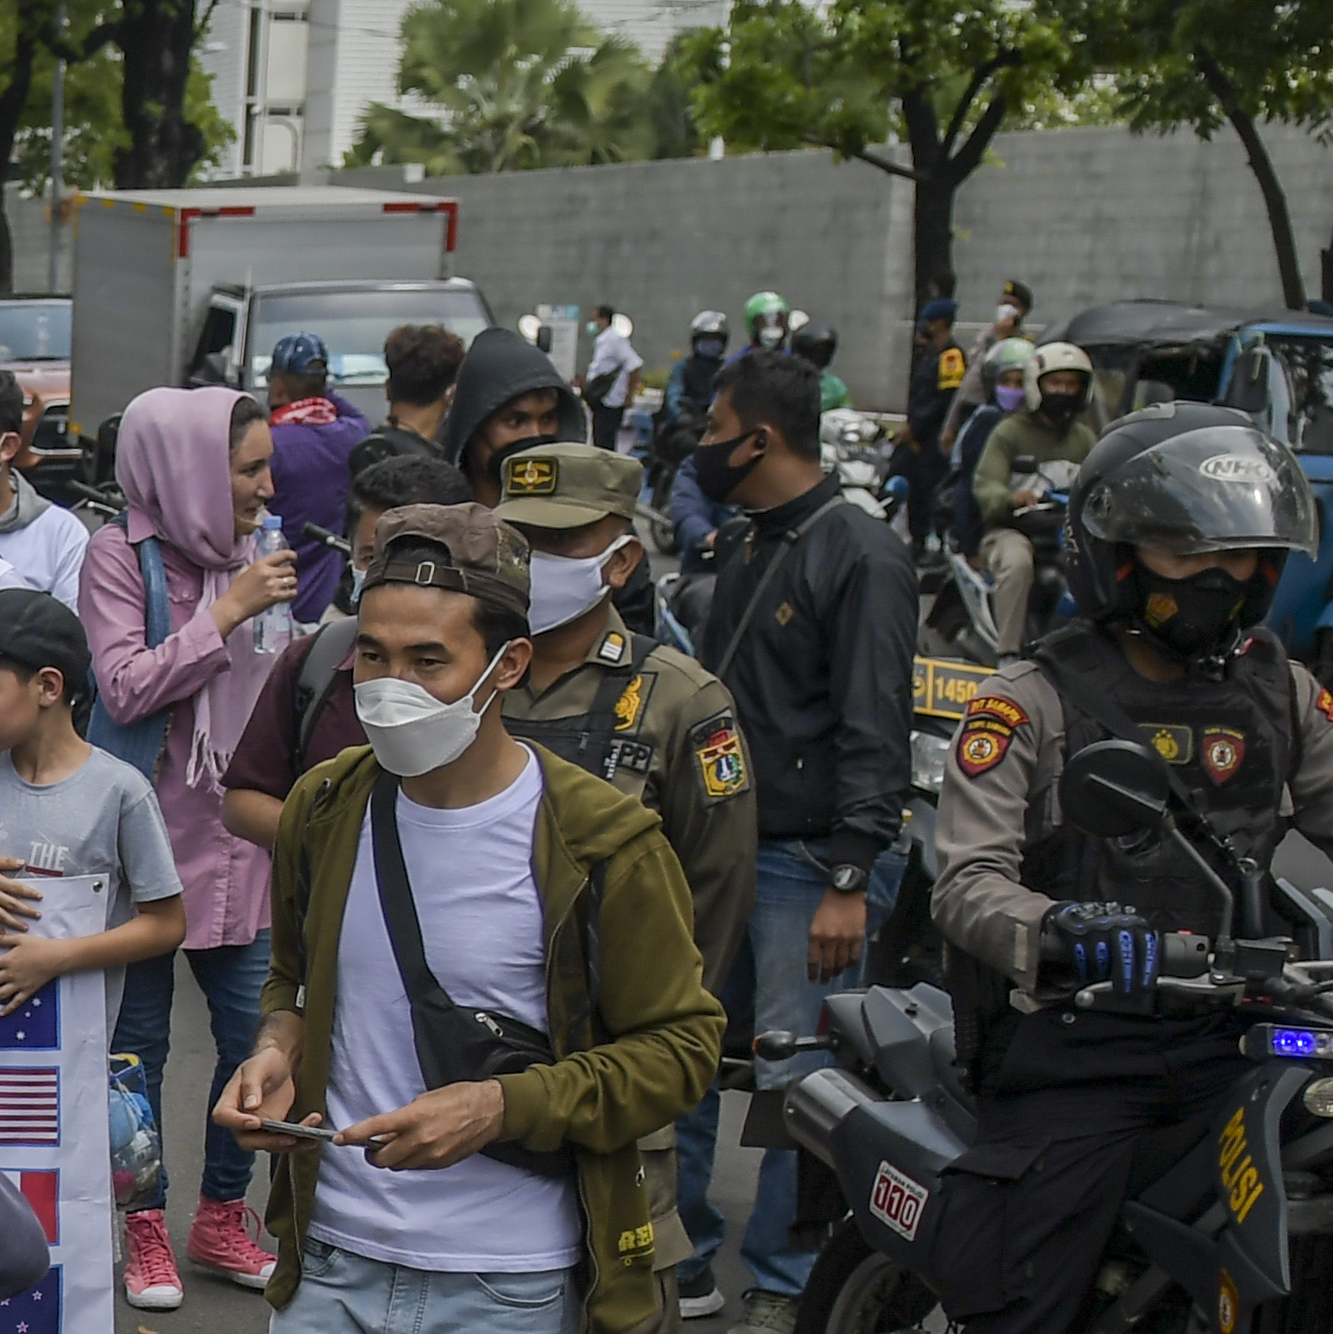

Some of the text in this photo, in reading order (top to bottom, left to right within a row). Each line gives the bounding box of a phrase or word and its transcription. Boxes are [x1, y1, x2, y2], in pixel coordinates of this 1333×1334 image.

[29, 840, 70, 871] THE
[1219, 1106, 1265, 1224] POLISI
[879, 1181, 917, 1226] 110
